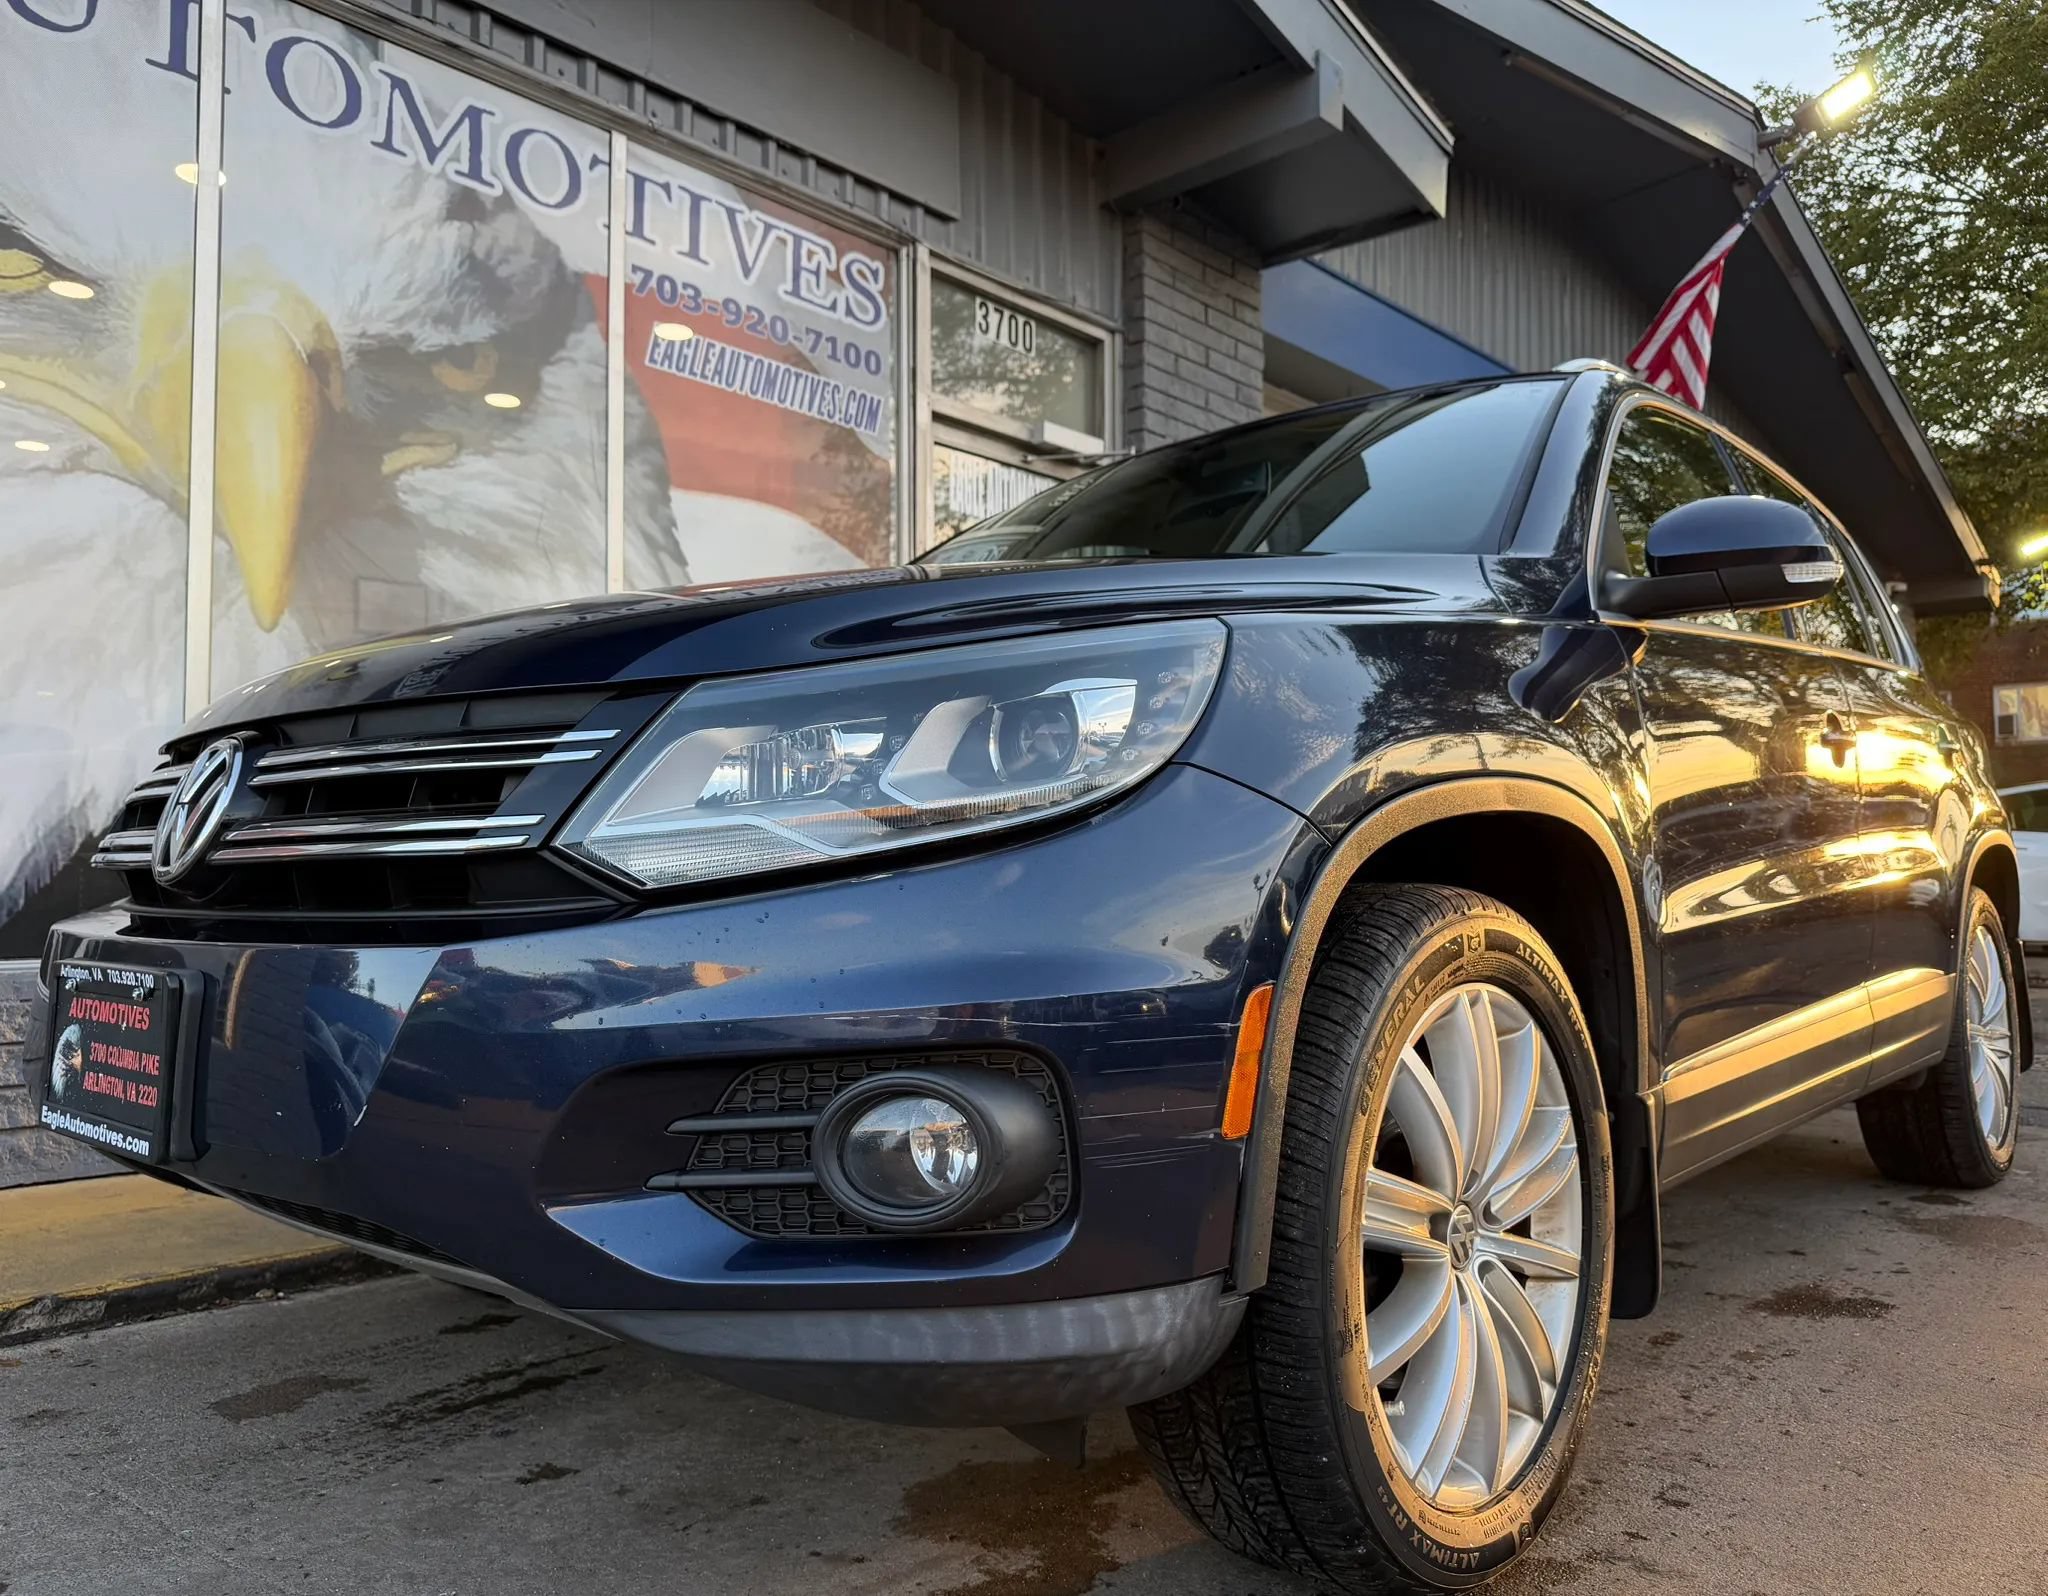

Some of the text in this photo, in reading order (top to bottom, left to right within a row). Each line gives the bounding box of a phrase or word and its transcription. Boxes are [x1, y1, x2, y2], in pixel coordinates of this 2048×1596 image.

[631, 264, 882, 376] 703-920-7100
[978, 301, 1033, 354] 3700
[648, 331, 882, 433] EAGLEAUTOMOTIVES.COM
[60, 963, 154, 989] Arlington, VA 703.920.7100
[1515, 943, 1568, 1003] ALTIMAX
[69, 997, 150, 1031] AUTOMOTIVES
[107, 1045, 140, 1072] COLUMBIA
[141, 1053, 160, 1075] PIKE
[83, 1071, 125, 1100] ARLINGTON,
[126, 1081, 137, 1102] VA
[41, 1105, 150, 1156] EagleAutomotives.com
[1409, 1529, 1480, 1569] ALTIMAX
